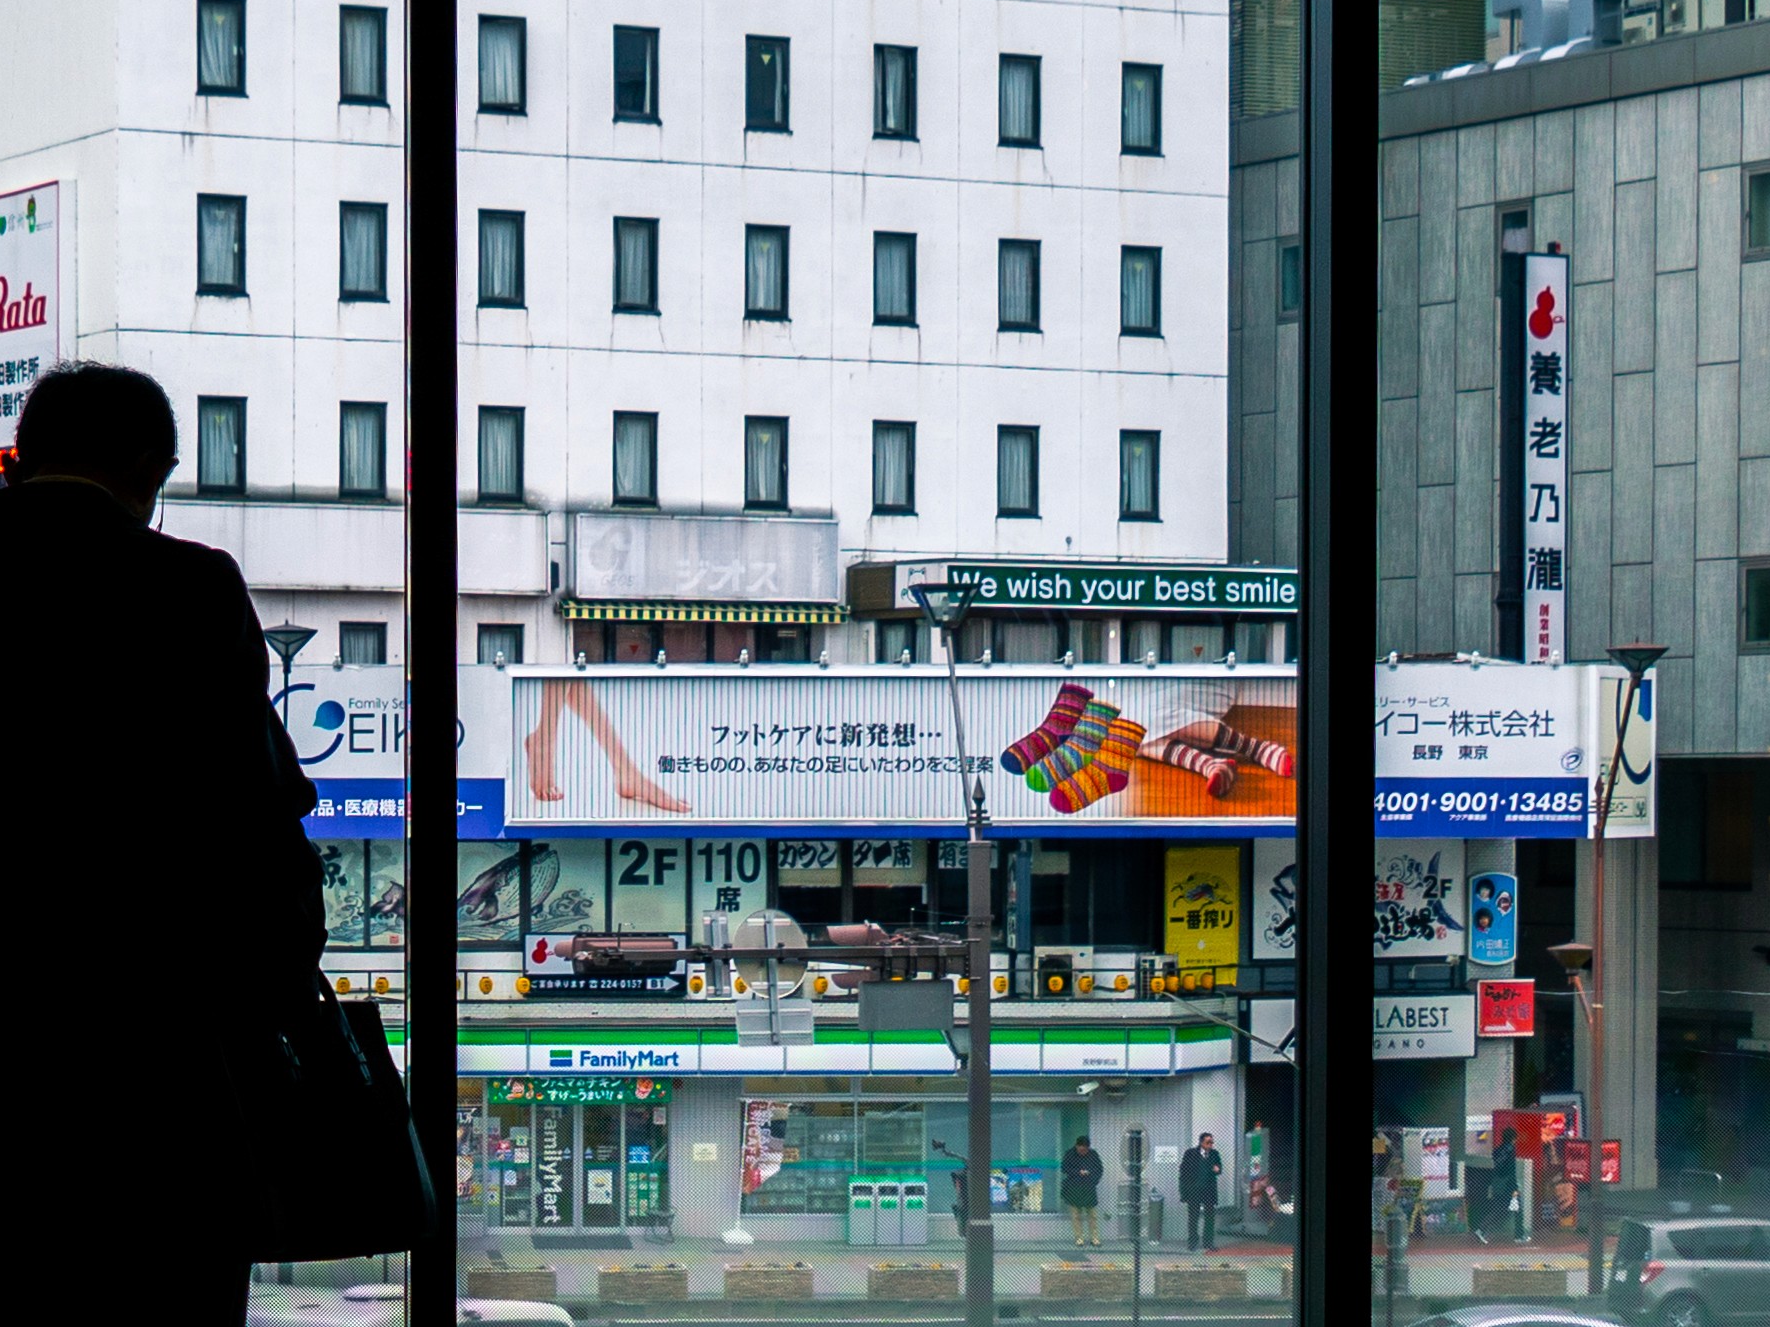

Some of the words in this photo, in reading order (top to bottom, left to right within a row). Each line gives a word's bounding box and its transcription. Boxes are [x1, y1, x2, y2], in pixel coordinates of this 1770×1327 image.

[1526, 351, 1563, 591] 養老乃瀧
[1007, 571, 1071, 600] wish
[1081, 577, 1144, 605] your
[1155, 576, 1217, 602] best
[1225, 576, 1296, 604] smile
[1375, 687, 1450, 708] リー・サービス
[1374, 709, 1556, 738] イコー株式会社
[1412, 743, 1444, 761] 長野
[1458, 743, 1489, 761] 東京
[619, 839, 678, 886] 2F
[697, 840, 761, 885] 110
[714, 886, 742, 913] 席
[1376, 882, 1405, 901] 酒屋
[1422, 875, 1453, 899] 2F
[1168, 909, 1234, 933] 一番搾り
[579, 1049, 680, 1070] FamilyMart
[542, 1105, 564, 1224] FamilyMart
